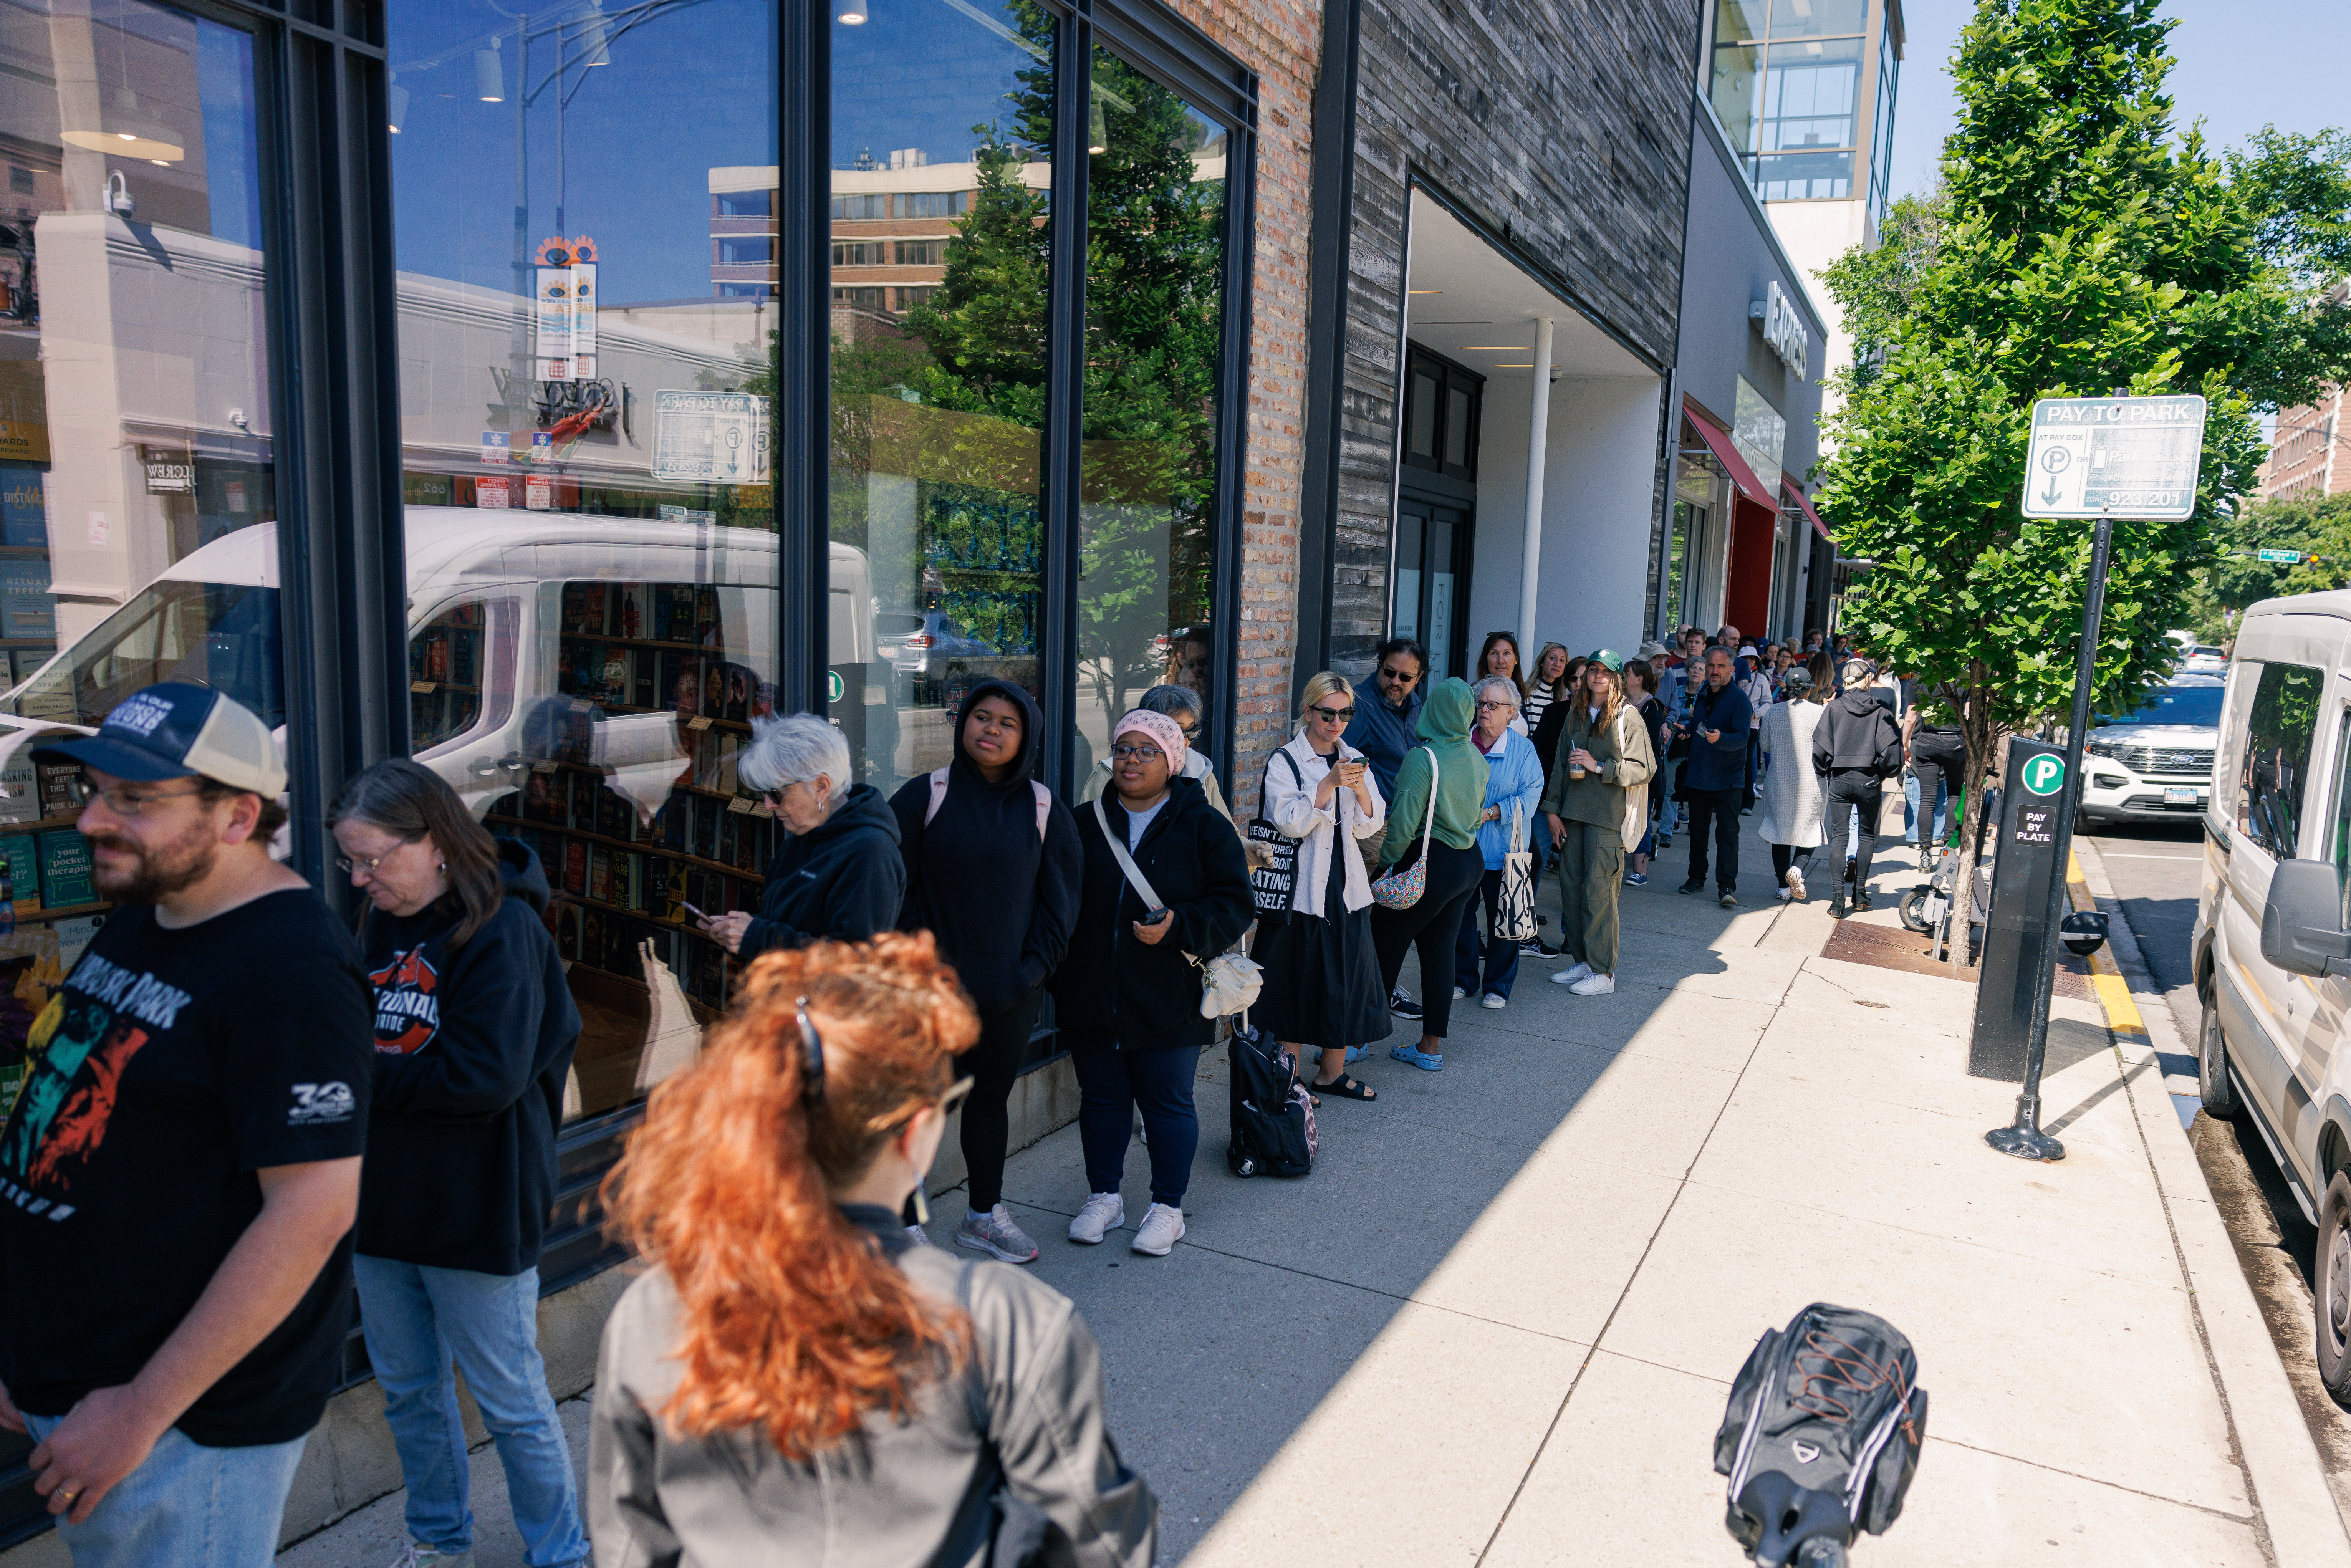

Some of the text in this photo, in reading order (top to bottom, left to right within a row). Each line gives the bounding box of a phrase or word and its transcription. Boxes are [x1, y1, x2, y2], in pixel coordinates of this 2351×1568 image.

[2047, 404, 2190, 422] PAY TO PARK
[2049, 451, 2065, 469] P
[404, 489, 424, 498] worthy
[622, 489, 679, 501] New & Noteworthy
[2109, 492, 2142, 506] 923
[2147, 492, 2180, 506] 201
[673, 588, 692, 602] PATTERSON
[1435, 584, 1445, 639] FOR
[951, 690, 964, 699] FIVE
[946, 702, 961, 712] BRO
[948, 715, 958, 724] BLA
[47, 766, 81, 775] EVERYONE
[2035, 760, 2057, 788] P
[46, 802, 65, 810] PAIGE
[2026, 813, 2047, 822] PAY
[2017, 832, 2050, 841] PLATE
[57, 848, 80, 858] your
[571, 852, 580, 860] FOR
[53, 856, 86, 867] pocket
[47, 865, 91, 876] therapist
[614, 880, 624, 892] ONE
[1254, 890, 1286, 910] RSELF.
[69, 926, 94, 936] Mind
[59, 939, 83, 947] Your
